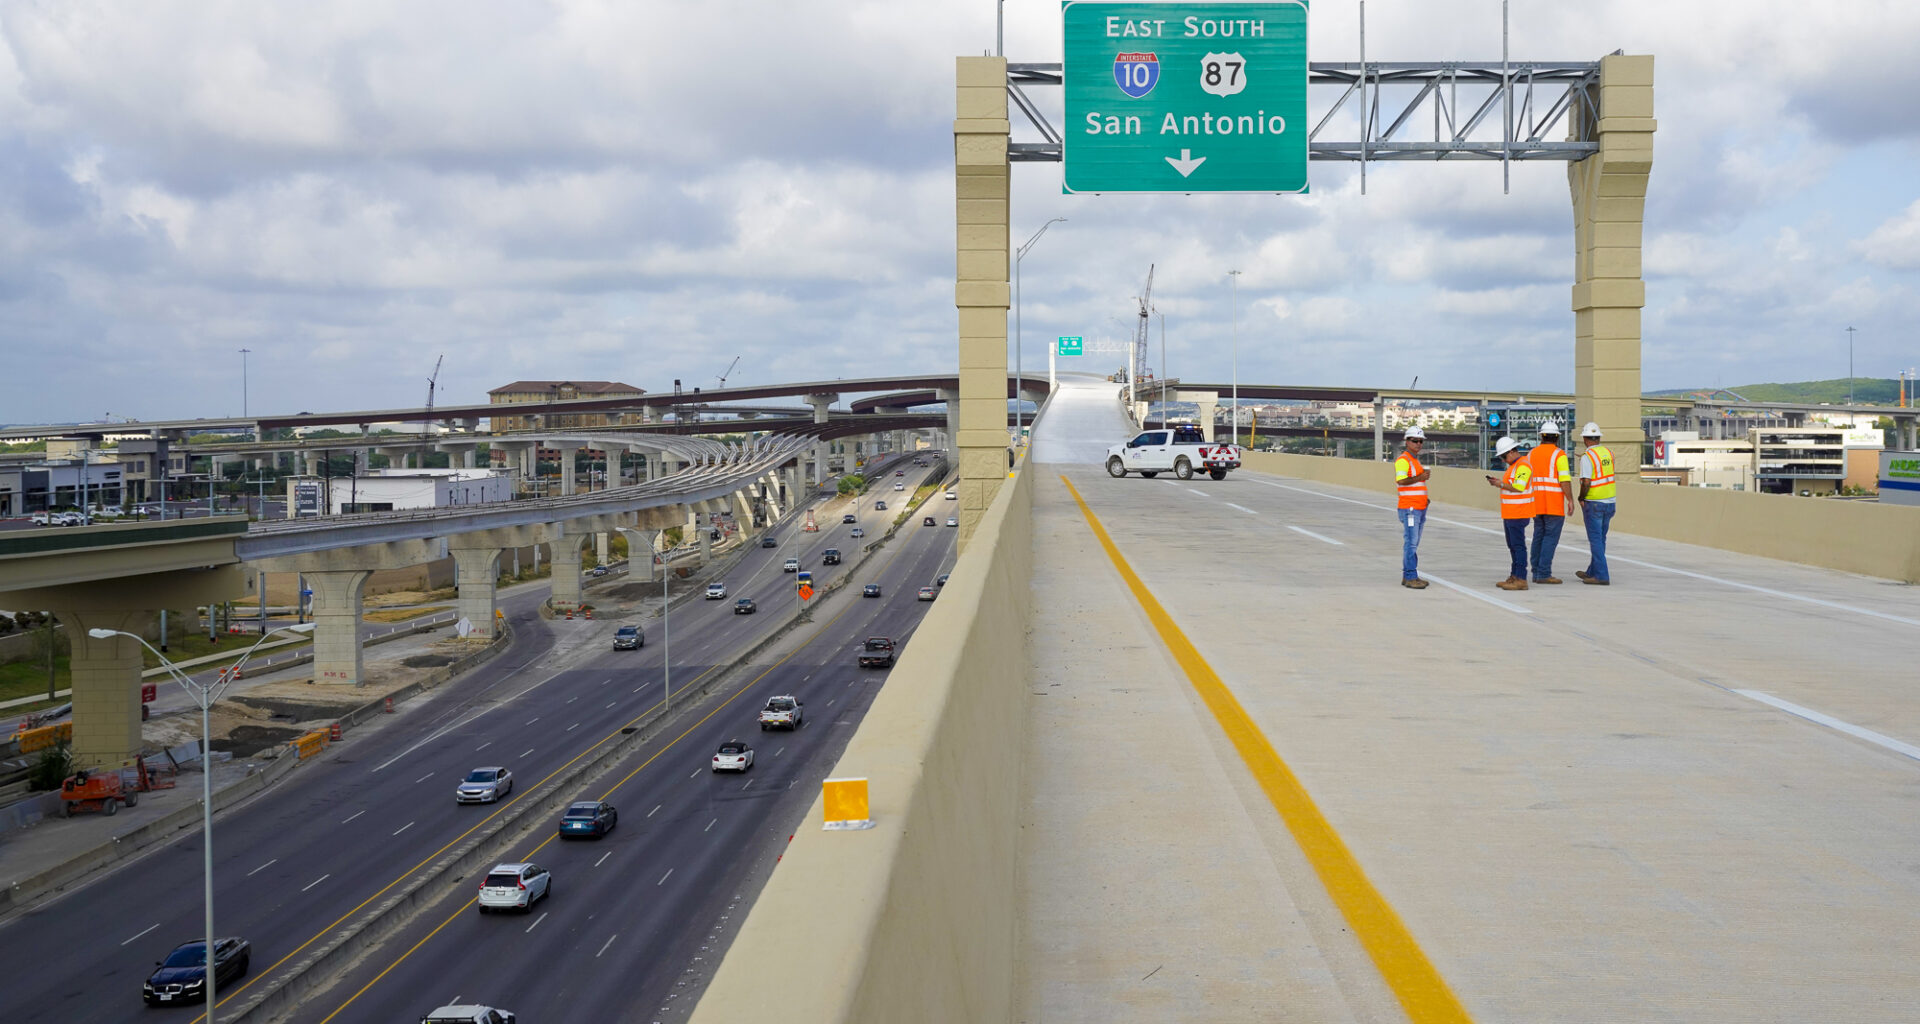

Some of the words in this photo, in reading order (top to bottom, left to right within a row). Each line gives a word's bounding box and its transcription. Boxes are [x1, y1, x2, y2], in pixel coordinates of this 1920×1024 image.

[1106, 16, 1166, 37] EAST
[1184, 16, 1265, 38] SOUTH
[1120, 54, 1152, 62] INTERSTATE
[1123, 63, 1149, 88] 10
[1205, 61, 1242, 87] 87
[1085, 111, 1141, 135] San
[1160, 109, 1286, 135] Antonio
